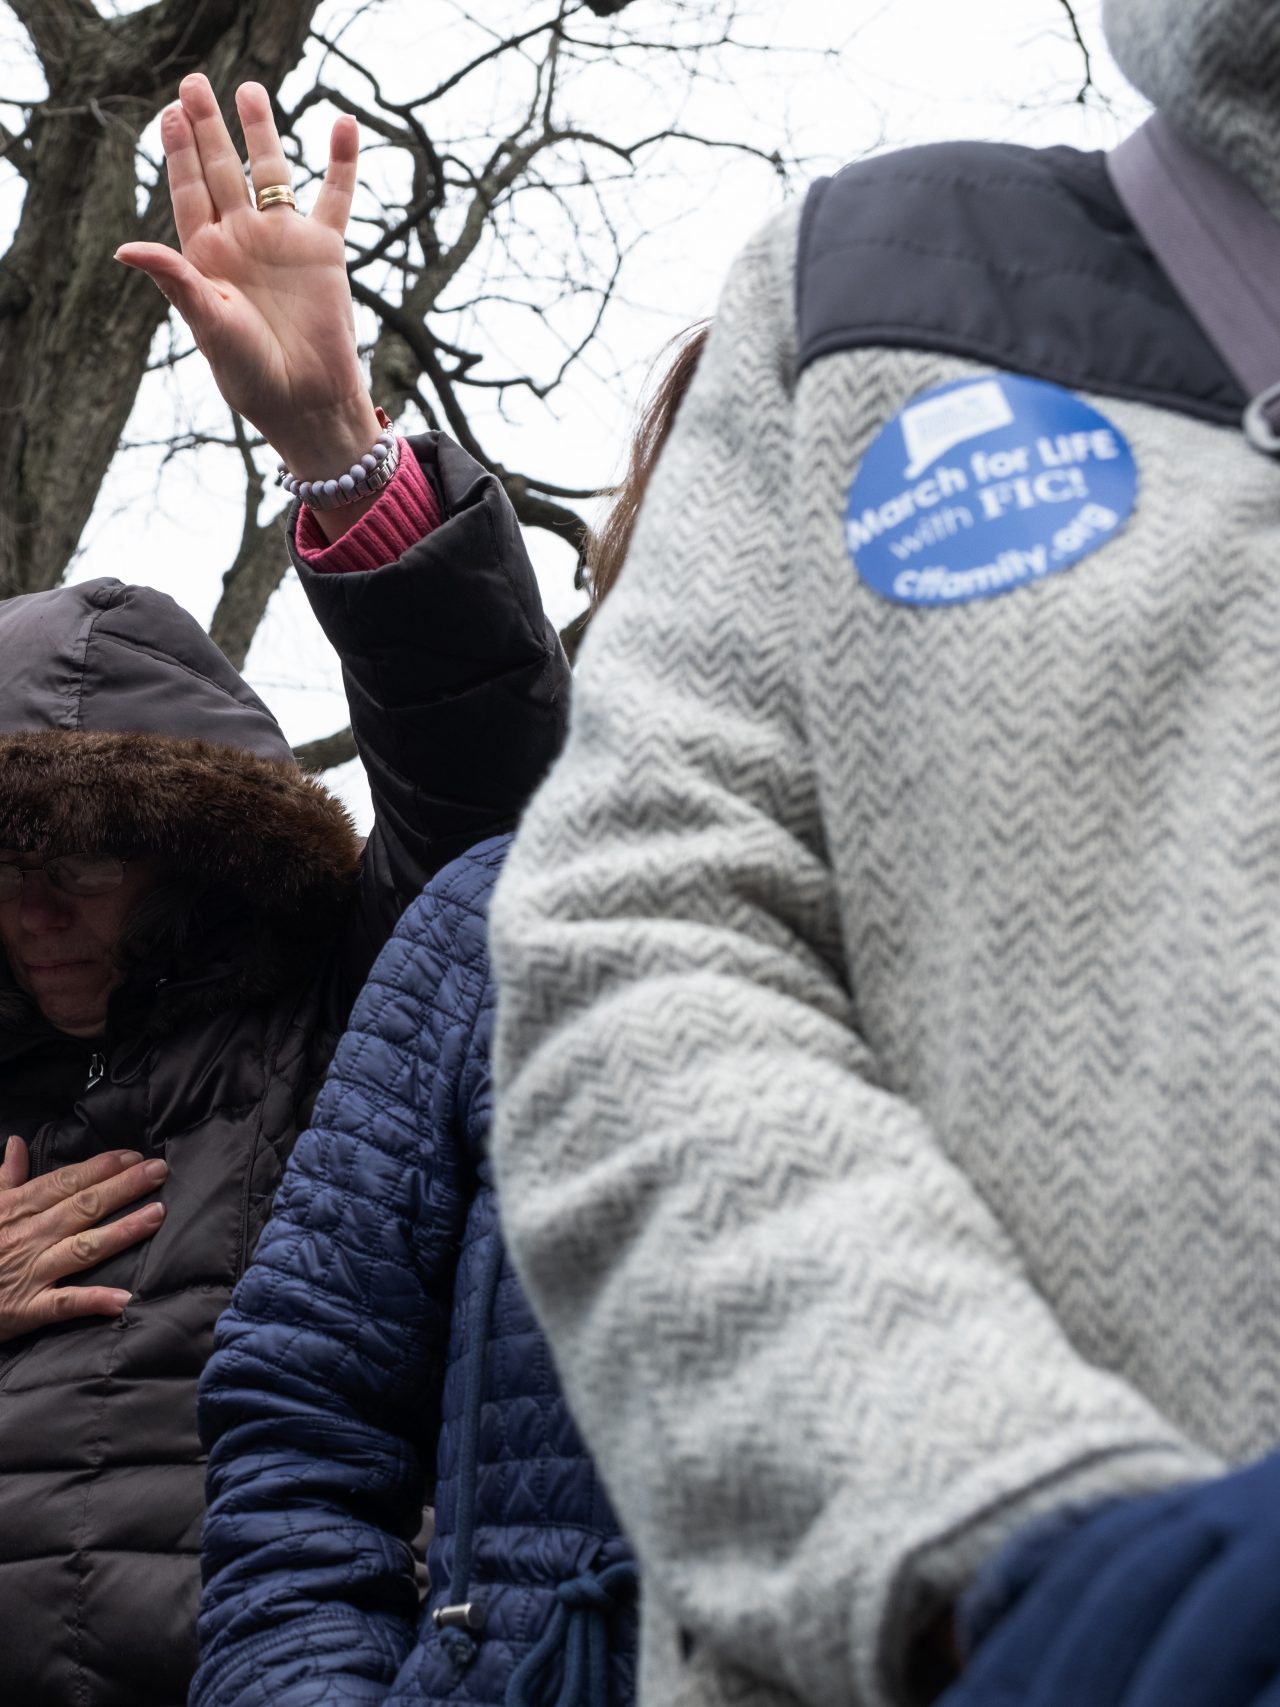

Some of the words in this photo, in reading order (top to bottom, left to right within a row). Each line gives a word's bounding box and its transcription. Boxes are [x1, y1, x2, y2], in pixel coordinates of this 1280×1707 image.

[846, 466, 968, 552] March
[971, 446, 1028, 483] for
[1037, 429, 1119, 468] LIFE
[889, 505, 974, 560] with
[978, 467, 1090, 521] FIC!
